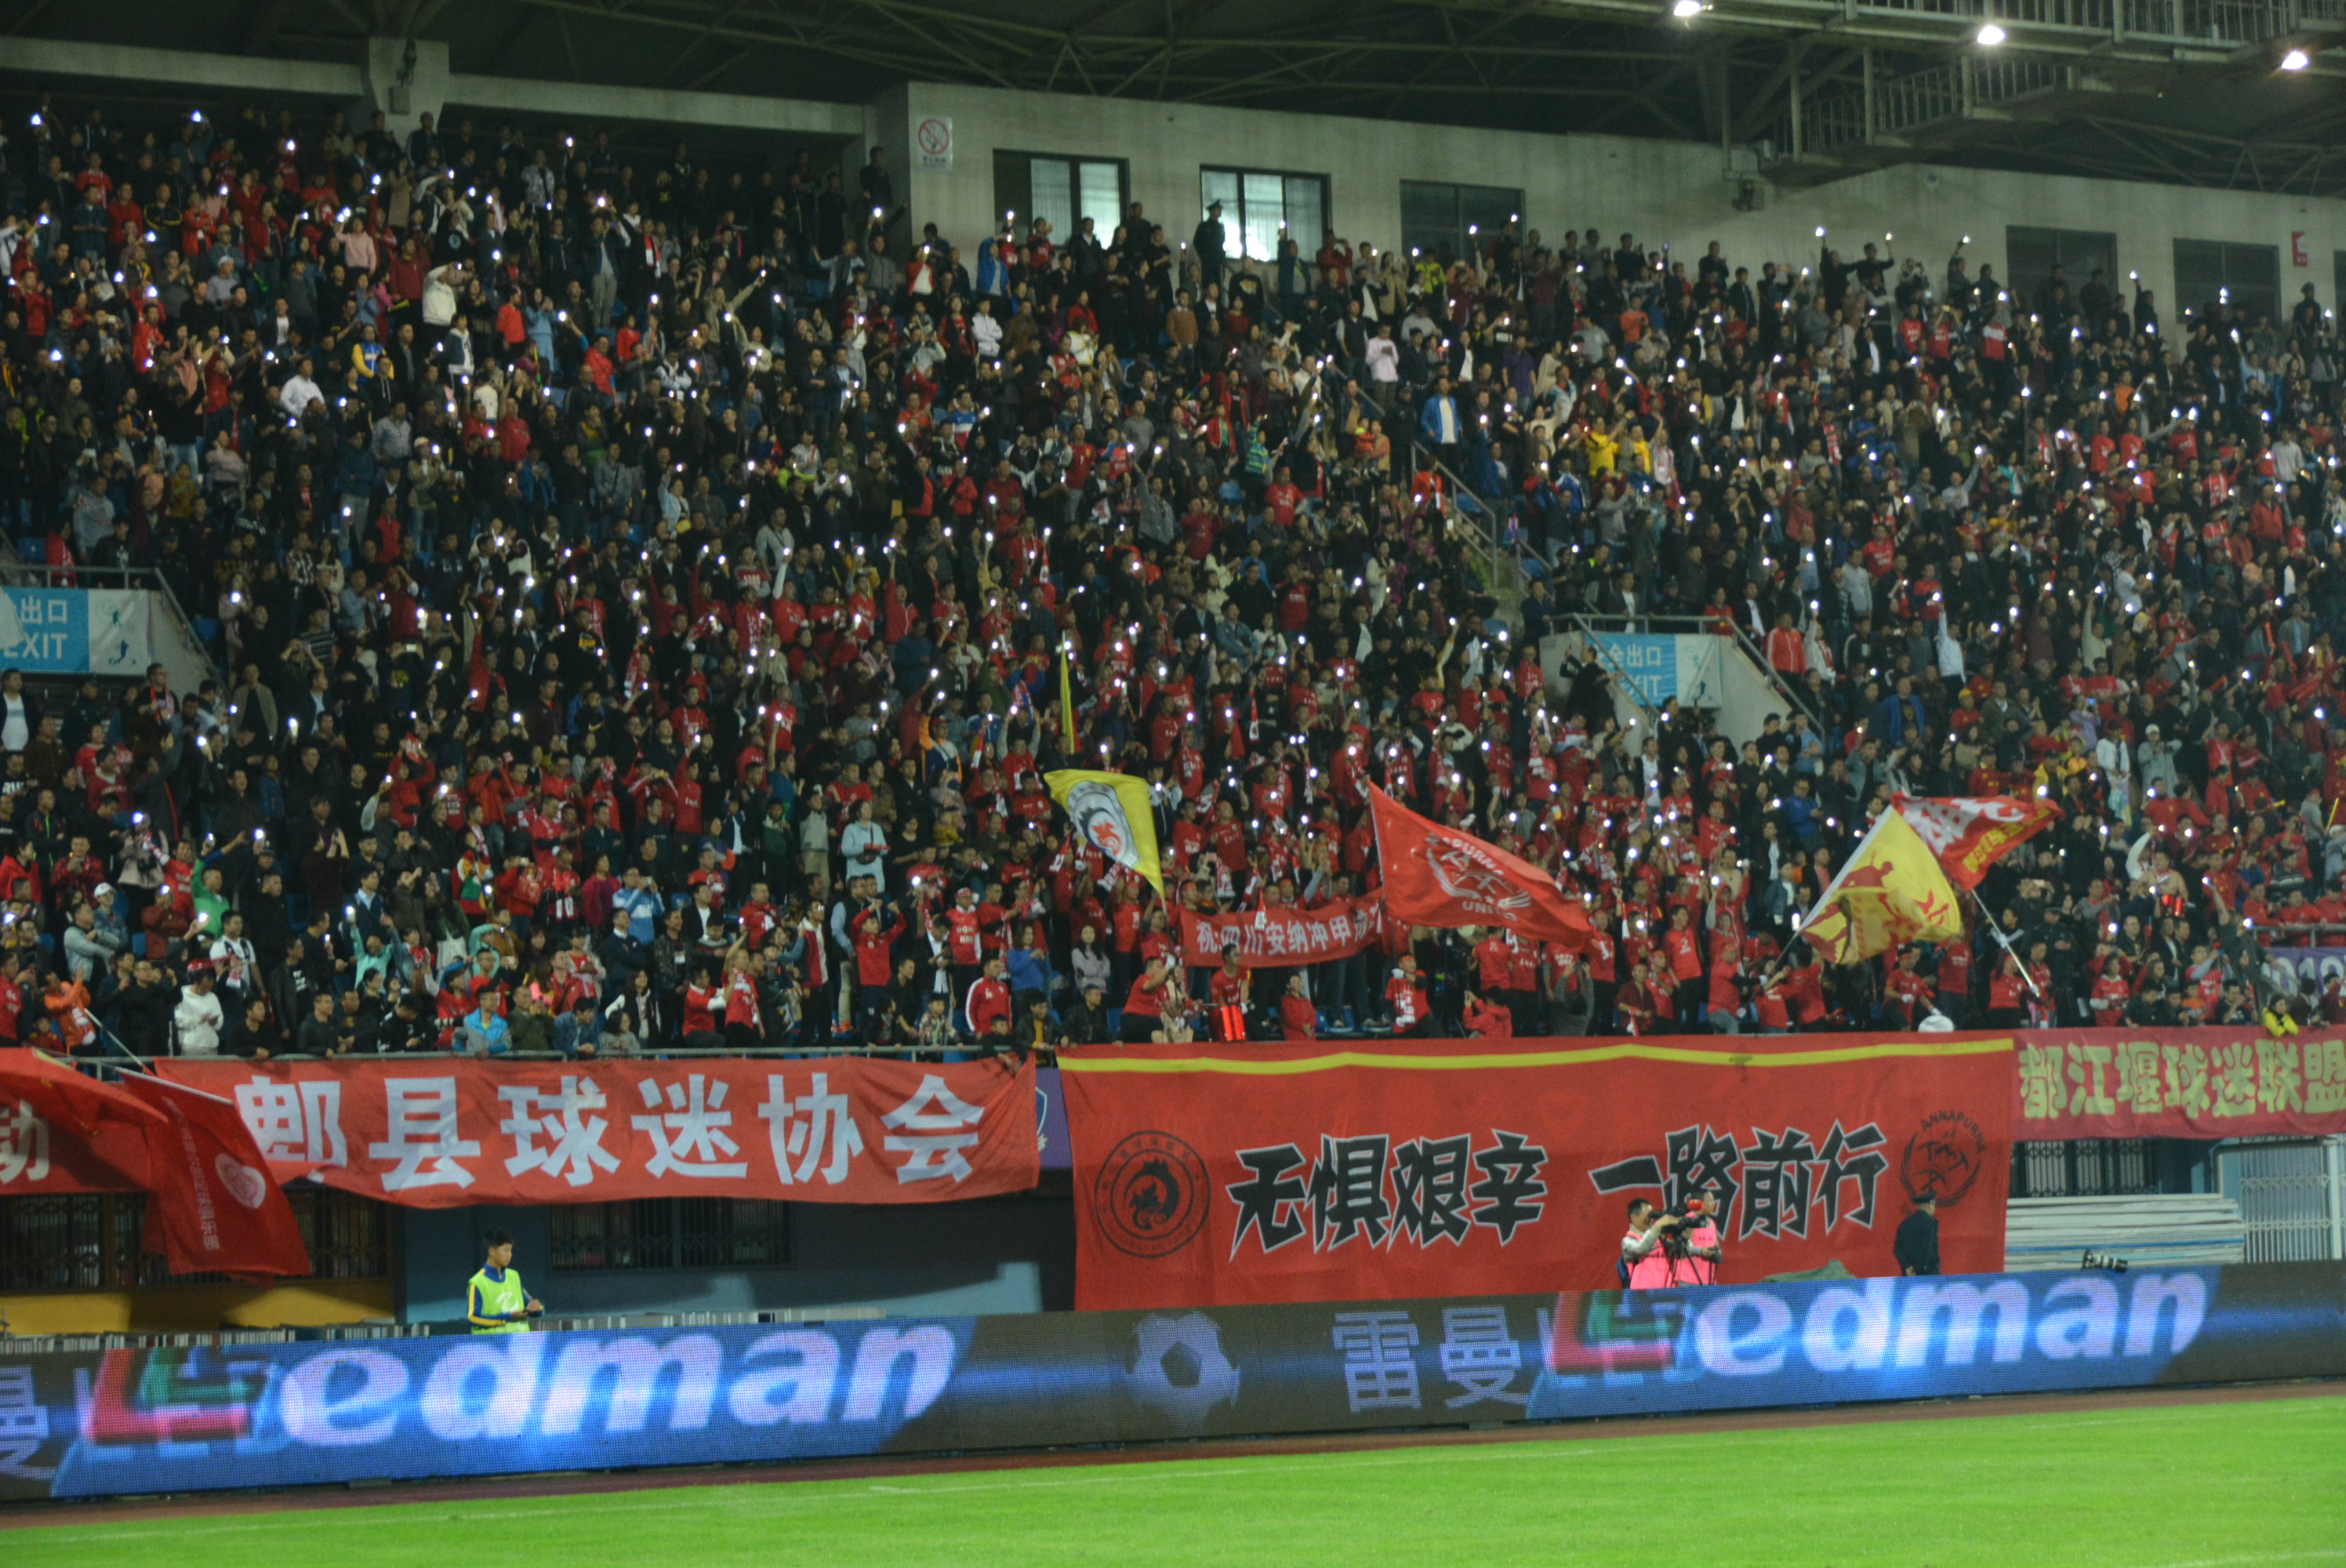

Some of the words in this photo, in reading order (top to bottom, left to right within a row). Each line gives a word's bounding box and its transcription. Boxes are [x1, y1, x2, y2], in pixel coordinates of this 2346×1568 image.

[20, 595, 68, 624] 出口
[234, 1074, 985, 1189] 郫县球迷协会
[2018, 1039, 2346, 1119] 都江堰球迷联盟
[1225, 1127, 1549, 1264] 无惧艰辛
[1588, 1118, 1890, 1242] 一路前行
[1332, 1305, 1528, 1414] 雷曼
